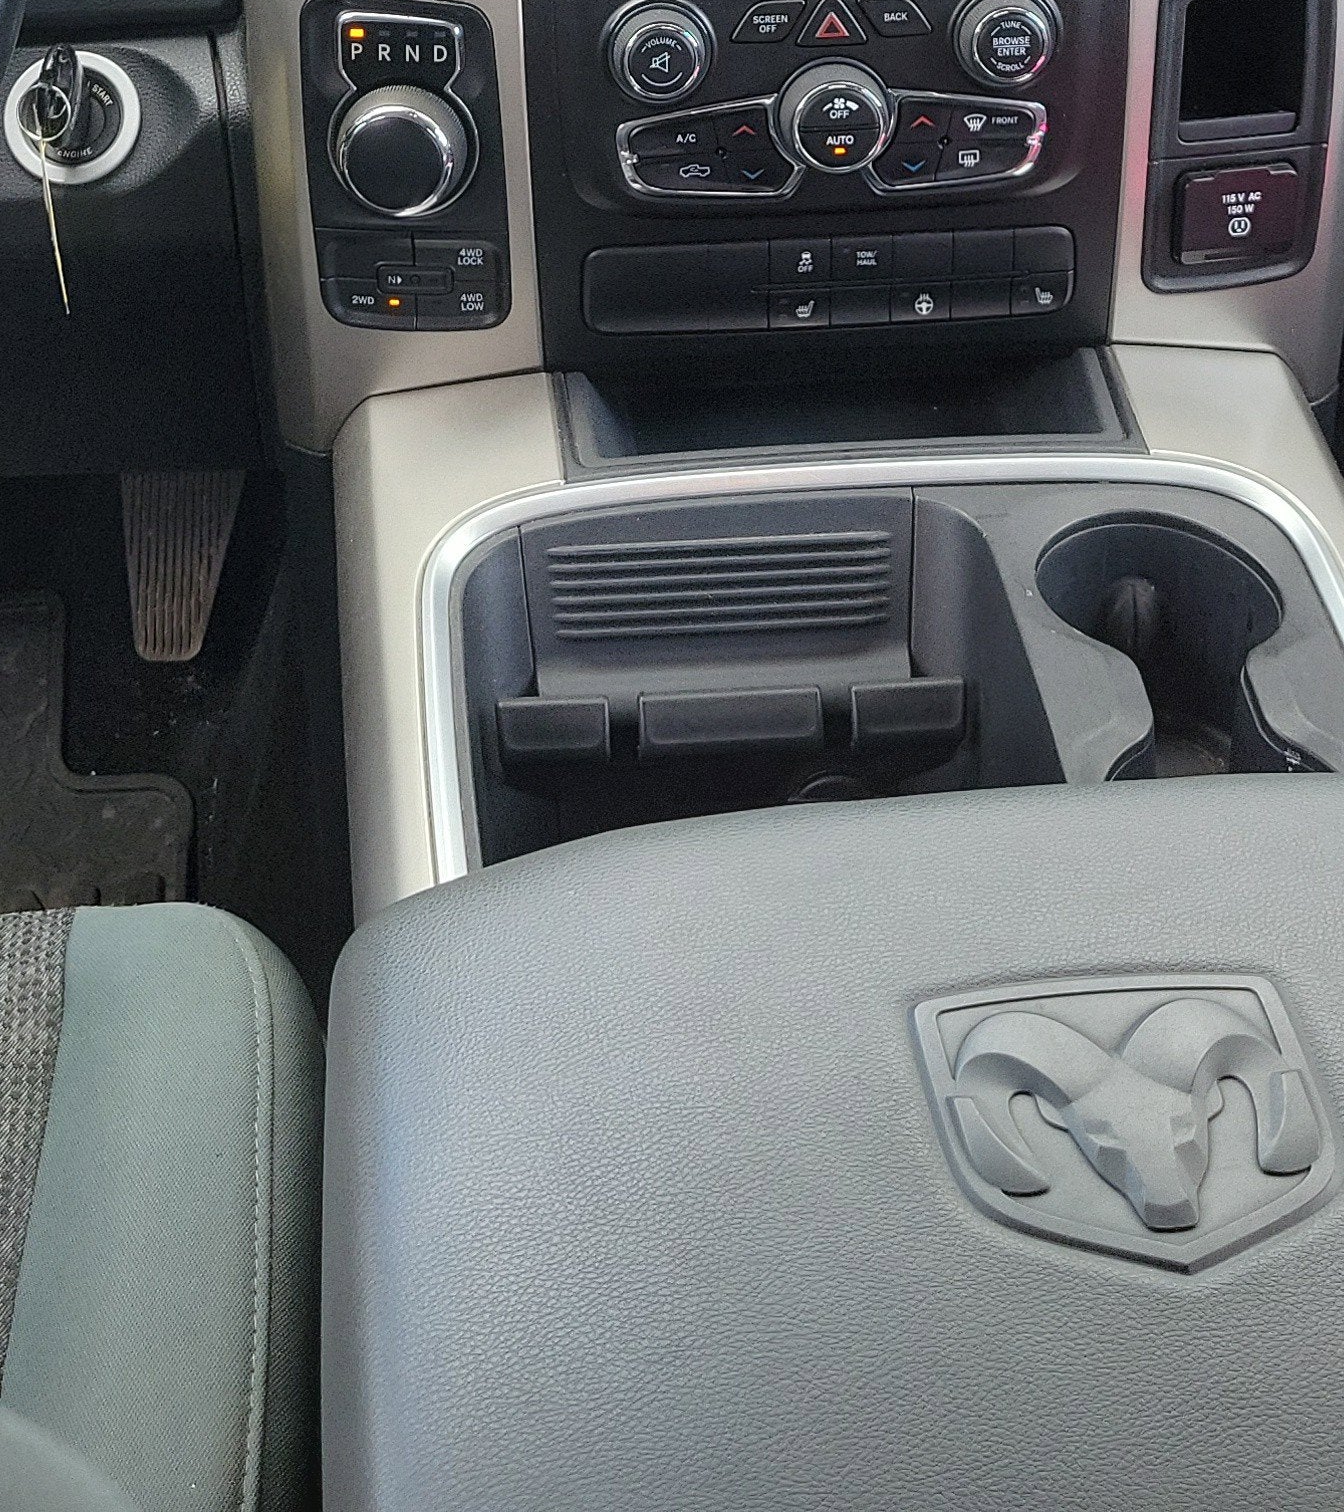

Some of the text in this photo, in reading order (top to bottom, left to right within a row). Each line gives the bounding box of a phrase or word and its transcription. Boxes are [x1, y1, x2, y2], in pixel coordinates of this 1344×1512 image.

[752, 14, 788, 24] SCREEN
[884, 11, 908, 22] BACK
[758, 24, 778, 34] OFF
[1000, 20, 1022, 30] TUNE
[646, 38, 678, 50] VOLUME
[992, 36, 1030, 47] BROWSE
[350, 43, 448, 62] P R N D
[996, 46, 1026, 57] ENTER
[996, 60, 1026, 72] SCROLL
[92, 84, 114, 107] START
[830, 108, 850, 119] OFF
[991, 114, 1018, 126] FRONT
[676, 133, 696, 144] A/C
[826, 134, 854, 146] AUTO
[1222, 191, 1262, 204] 115 V AC
[1227, 203, 1255, 214] 150 W
[459, 248, 483, 258] 4WD
[458, 256, 484, 266] LOCK
[856, 258, 876, 266] HAUL
[798, 263, 813, 273] OFF
[388, 275, 396, 285] N
[352, 296, 375, 305] 2WD
[460, 293, 483, 302] 4WD
[460, 302, 484, 311] LOW
